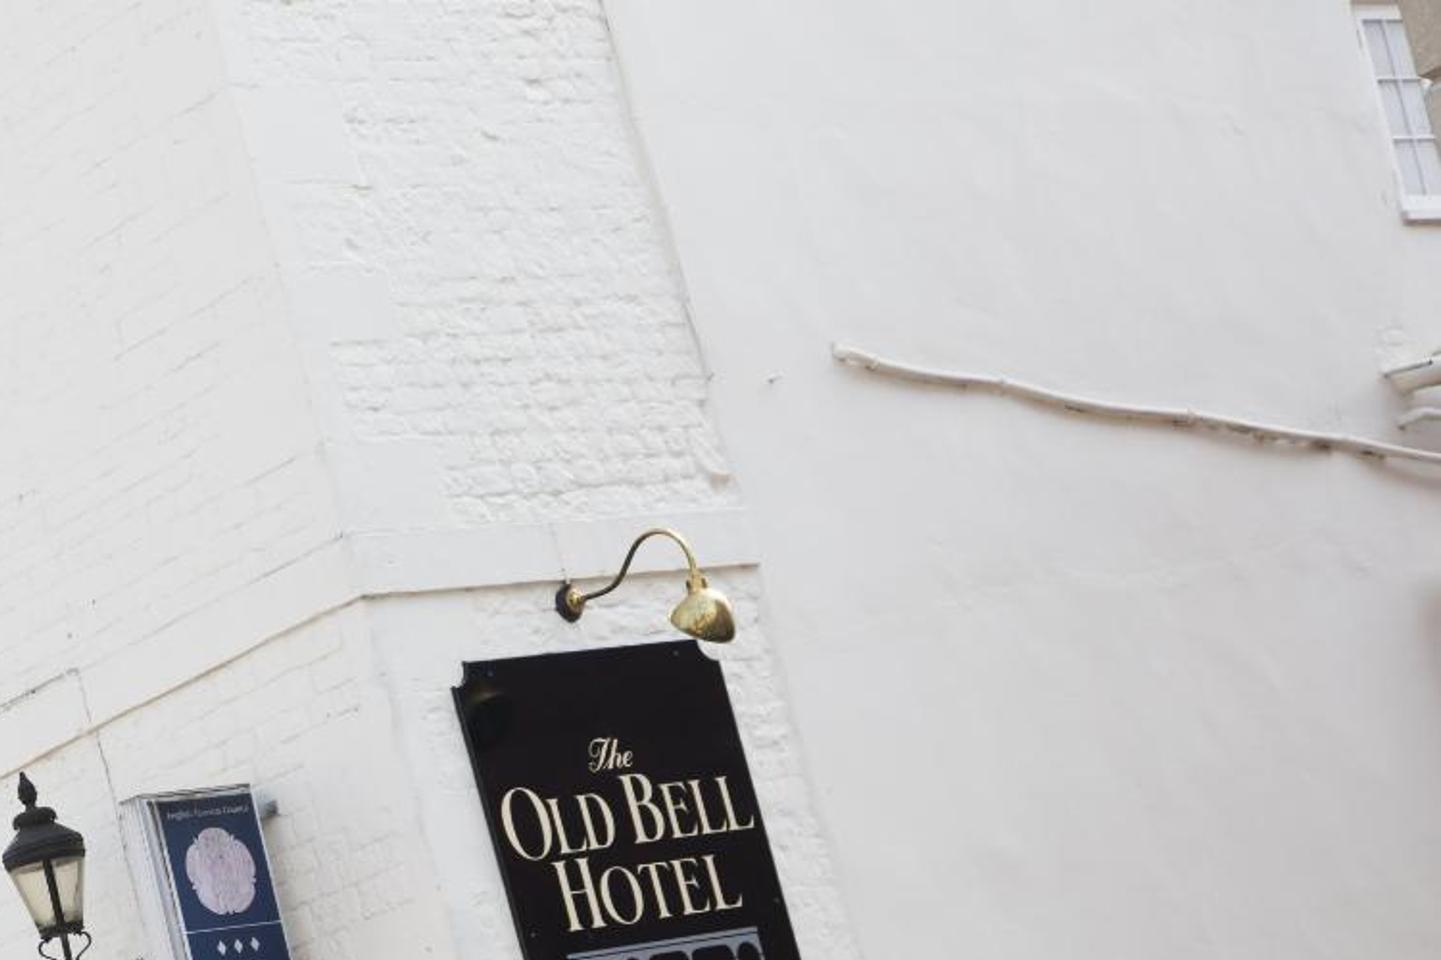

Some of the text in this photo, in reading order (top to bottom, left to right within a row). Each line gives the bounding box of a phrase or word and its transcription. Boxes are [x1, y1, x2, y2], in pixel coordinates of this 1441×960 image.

[587, 737, 633, 773] The
[500, 773, 754, 861] OLD BELL
[552, 853, 743, 932] HOTEL
